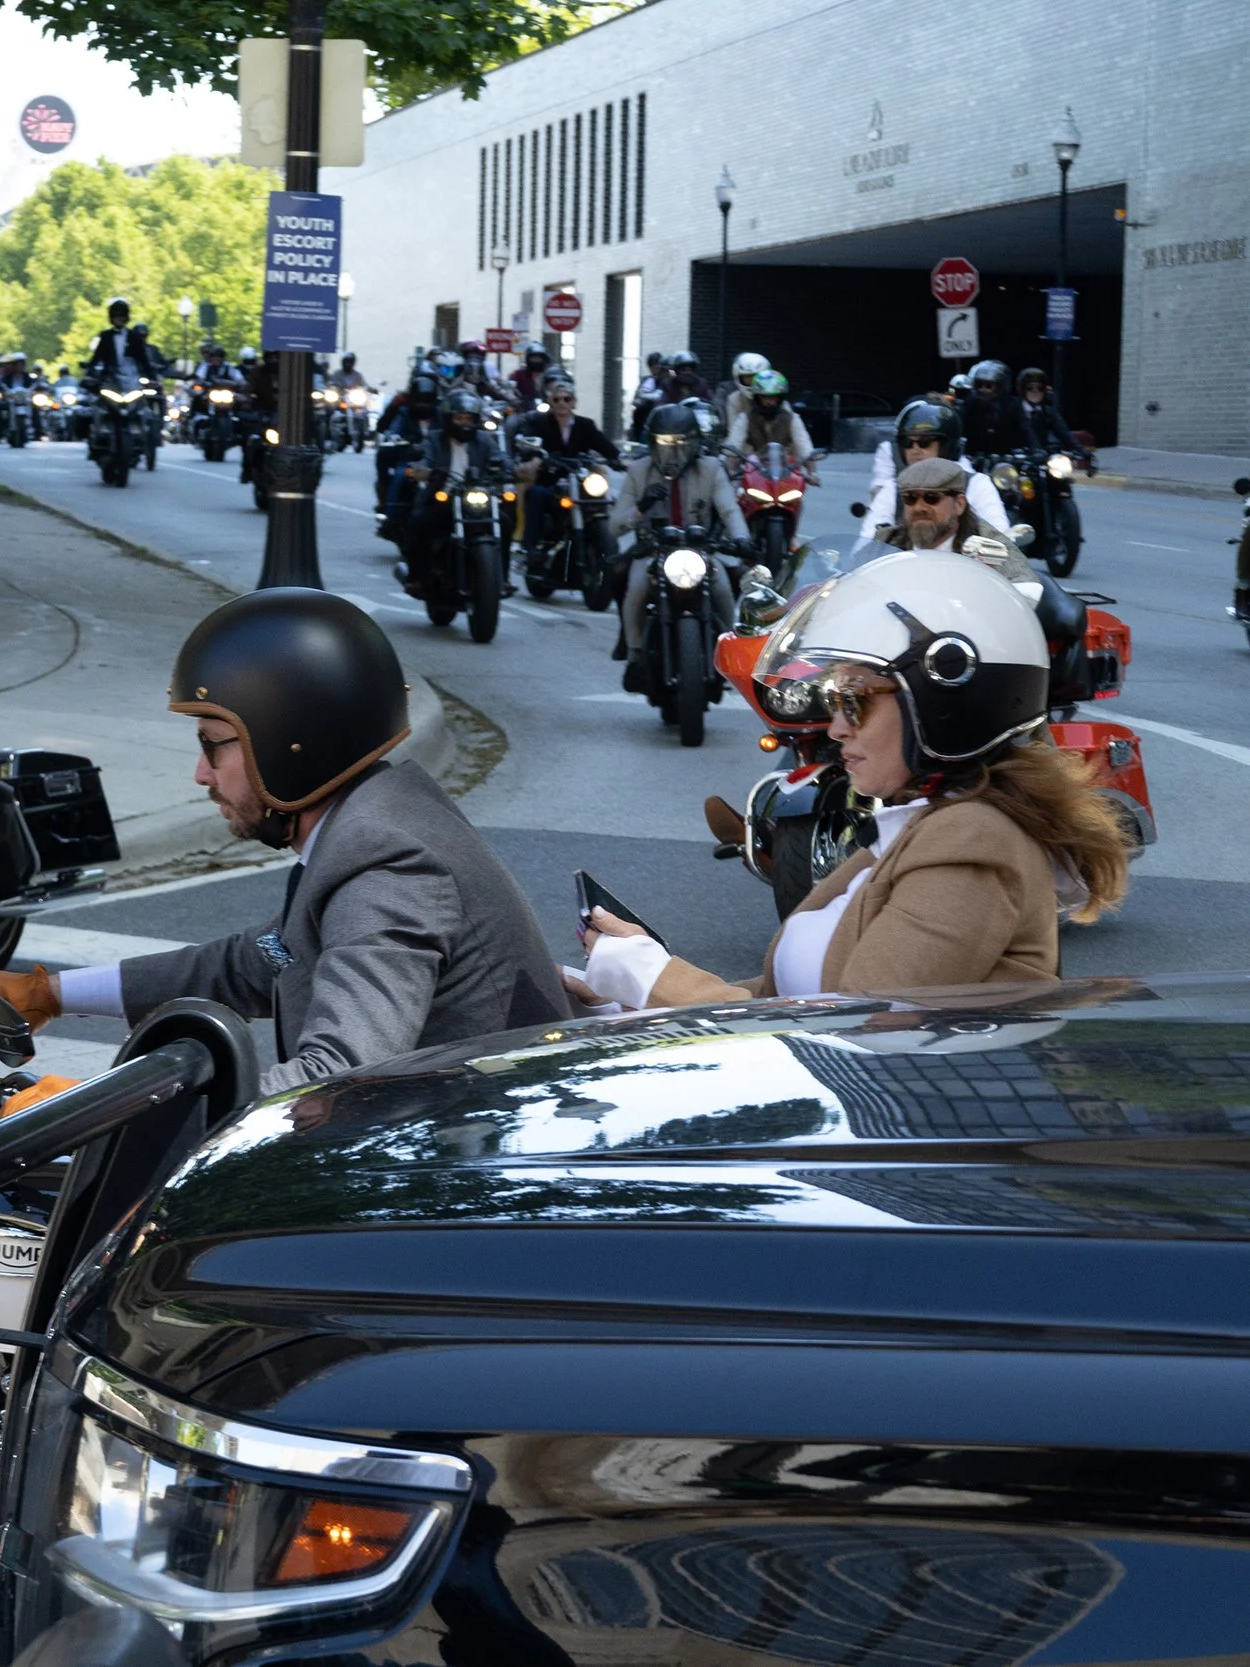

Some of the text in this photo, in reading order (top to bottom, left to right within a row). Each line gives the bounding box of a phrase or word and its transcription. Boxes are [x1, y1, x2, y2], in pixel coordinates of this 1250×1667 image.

[276, 215, 335, 232] YOUTH
[272, 233, 337, 250] ESCORT
[273, 252, 334, 268] POLICY
[267, 270, 338, 287] IN PLACE
[934, 272, 976, 293] STOP
[943, 340, 973, 353] ONLY
